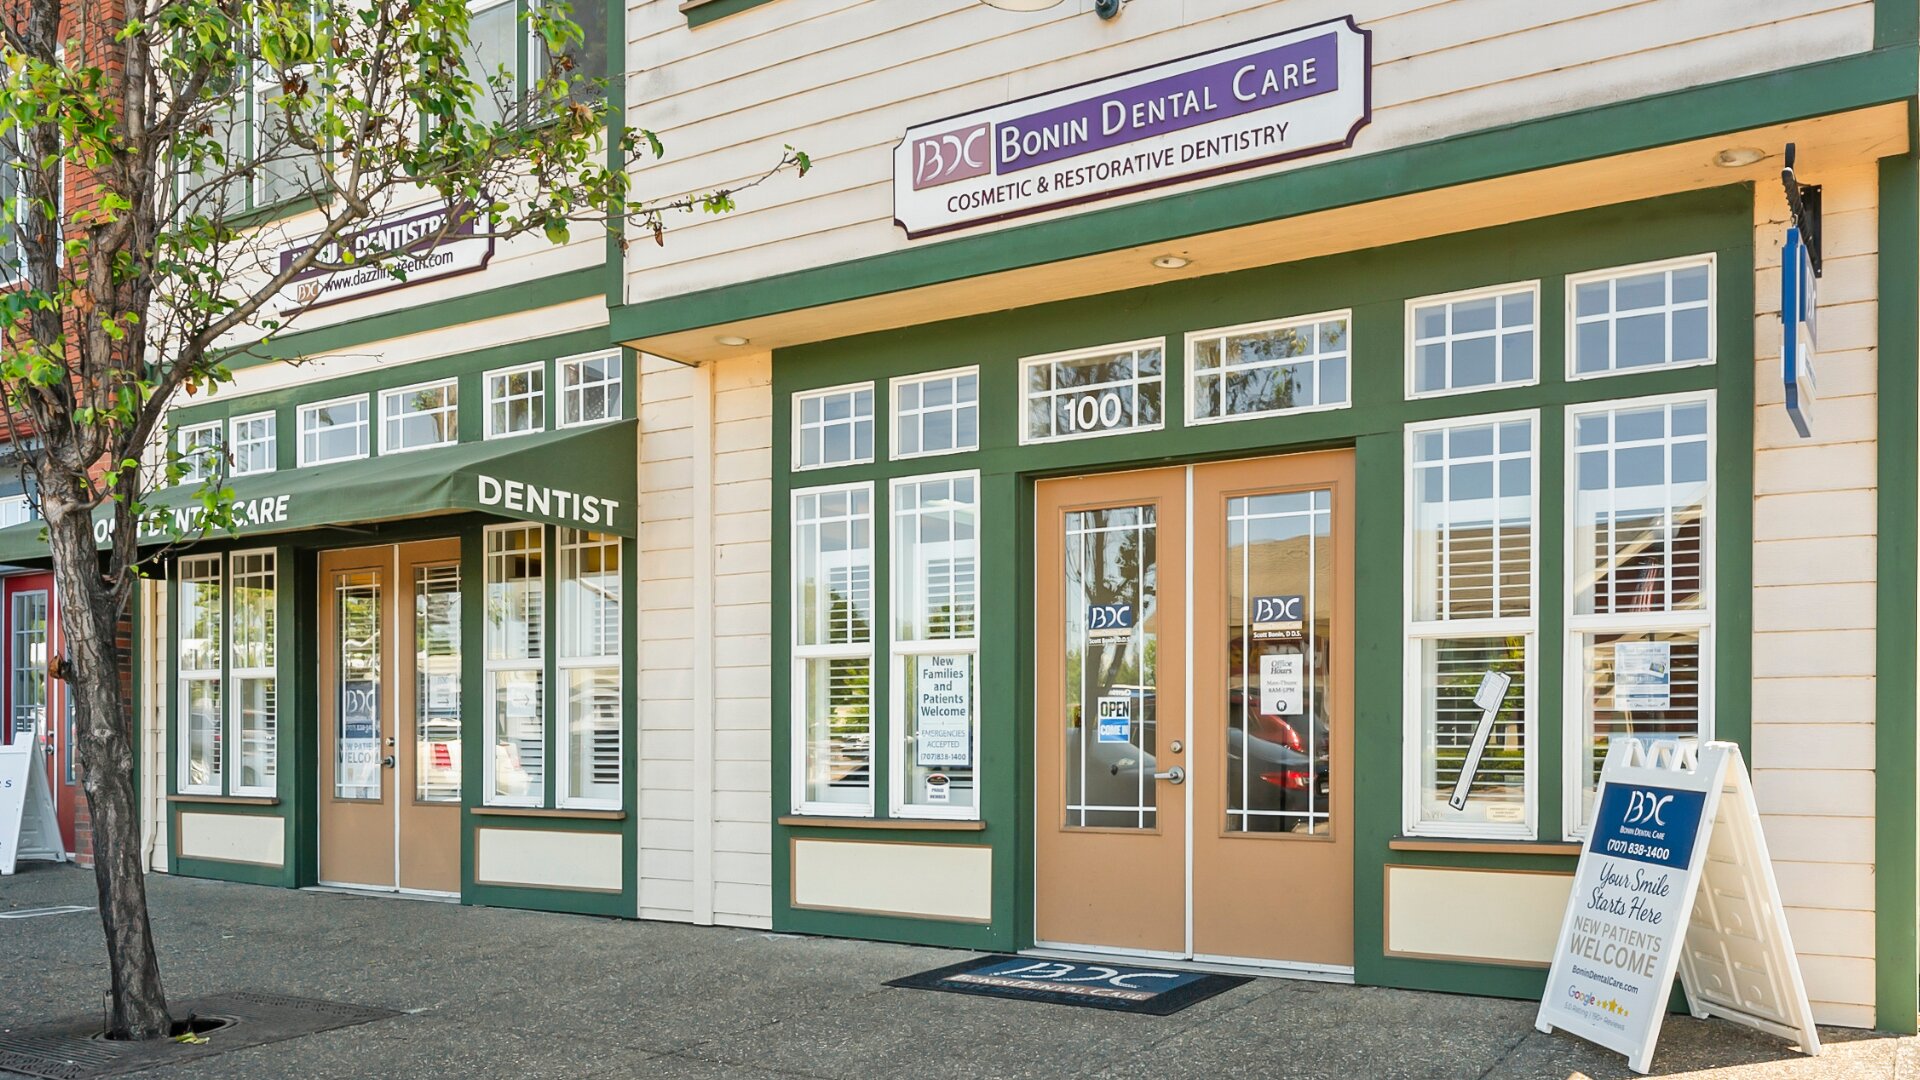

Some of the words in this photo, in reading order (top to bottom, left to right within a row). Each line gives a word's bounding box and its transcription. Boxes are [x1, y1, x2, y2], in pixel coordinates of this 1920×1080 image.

[1232, 57, 1317, 102] CARE
[947, 179, 1031, 213] COSMETIC
[1037, 176, 1049, 194] &
[1055, 149, 1174, 190] RESTORATIVE
[1181, 122, 1290, 163] DENTISTRY
[1064, 393, 1121, 431] 100
[478, 474, 619, 527] DENTIST
[932, 656, 954, 666] New
[1271, 667, 1293, 675] Hours
[923, 668, 963, 679] Families
[934, 680, 952, 691] and
[923, 693, 963, 704] Patients
[1100, 701, 1129, 717] OPEN
[921, 706, 966, 717] Welcome
[921, 730, 966, 738] EMERGENCIES
[927, 740, 960, 748] ACCEPTED
[1607, 839, 1627, 854] (707)
[1628, 842, 1670, 860] 838-1400
[1600, 862, 1630, 889] Your
[1631, 868, 1669, 897] Smile
[1587, 886, 1625, 915] Starts
[1628, 896, 1662, 925] Here
[1573, 915, 1601, 935] NEW
[1602, 923, 1662, 953] PATIENTS
[1570, 932, 1658, 979] WELCOME
[1572, 965, 1639, 995] BoninDentalCare.com
[1568, 984, 1595, 1006] Google
